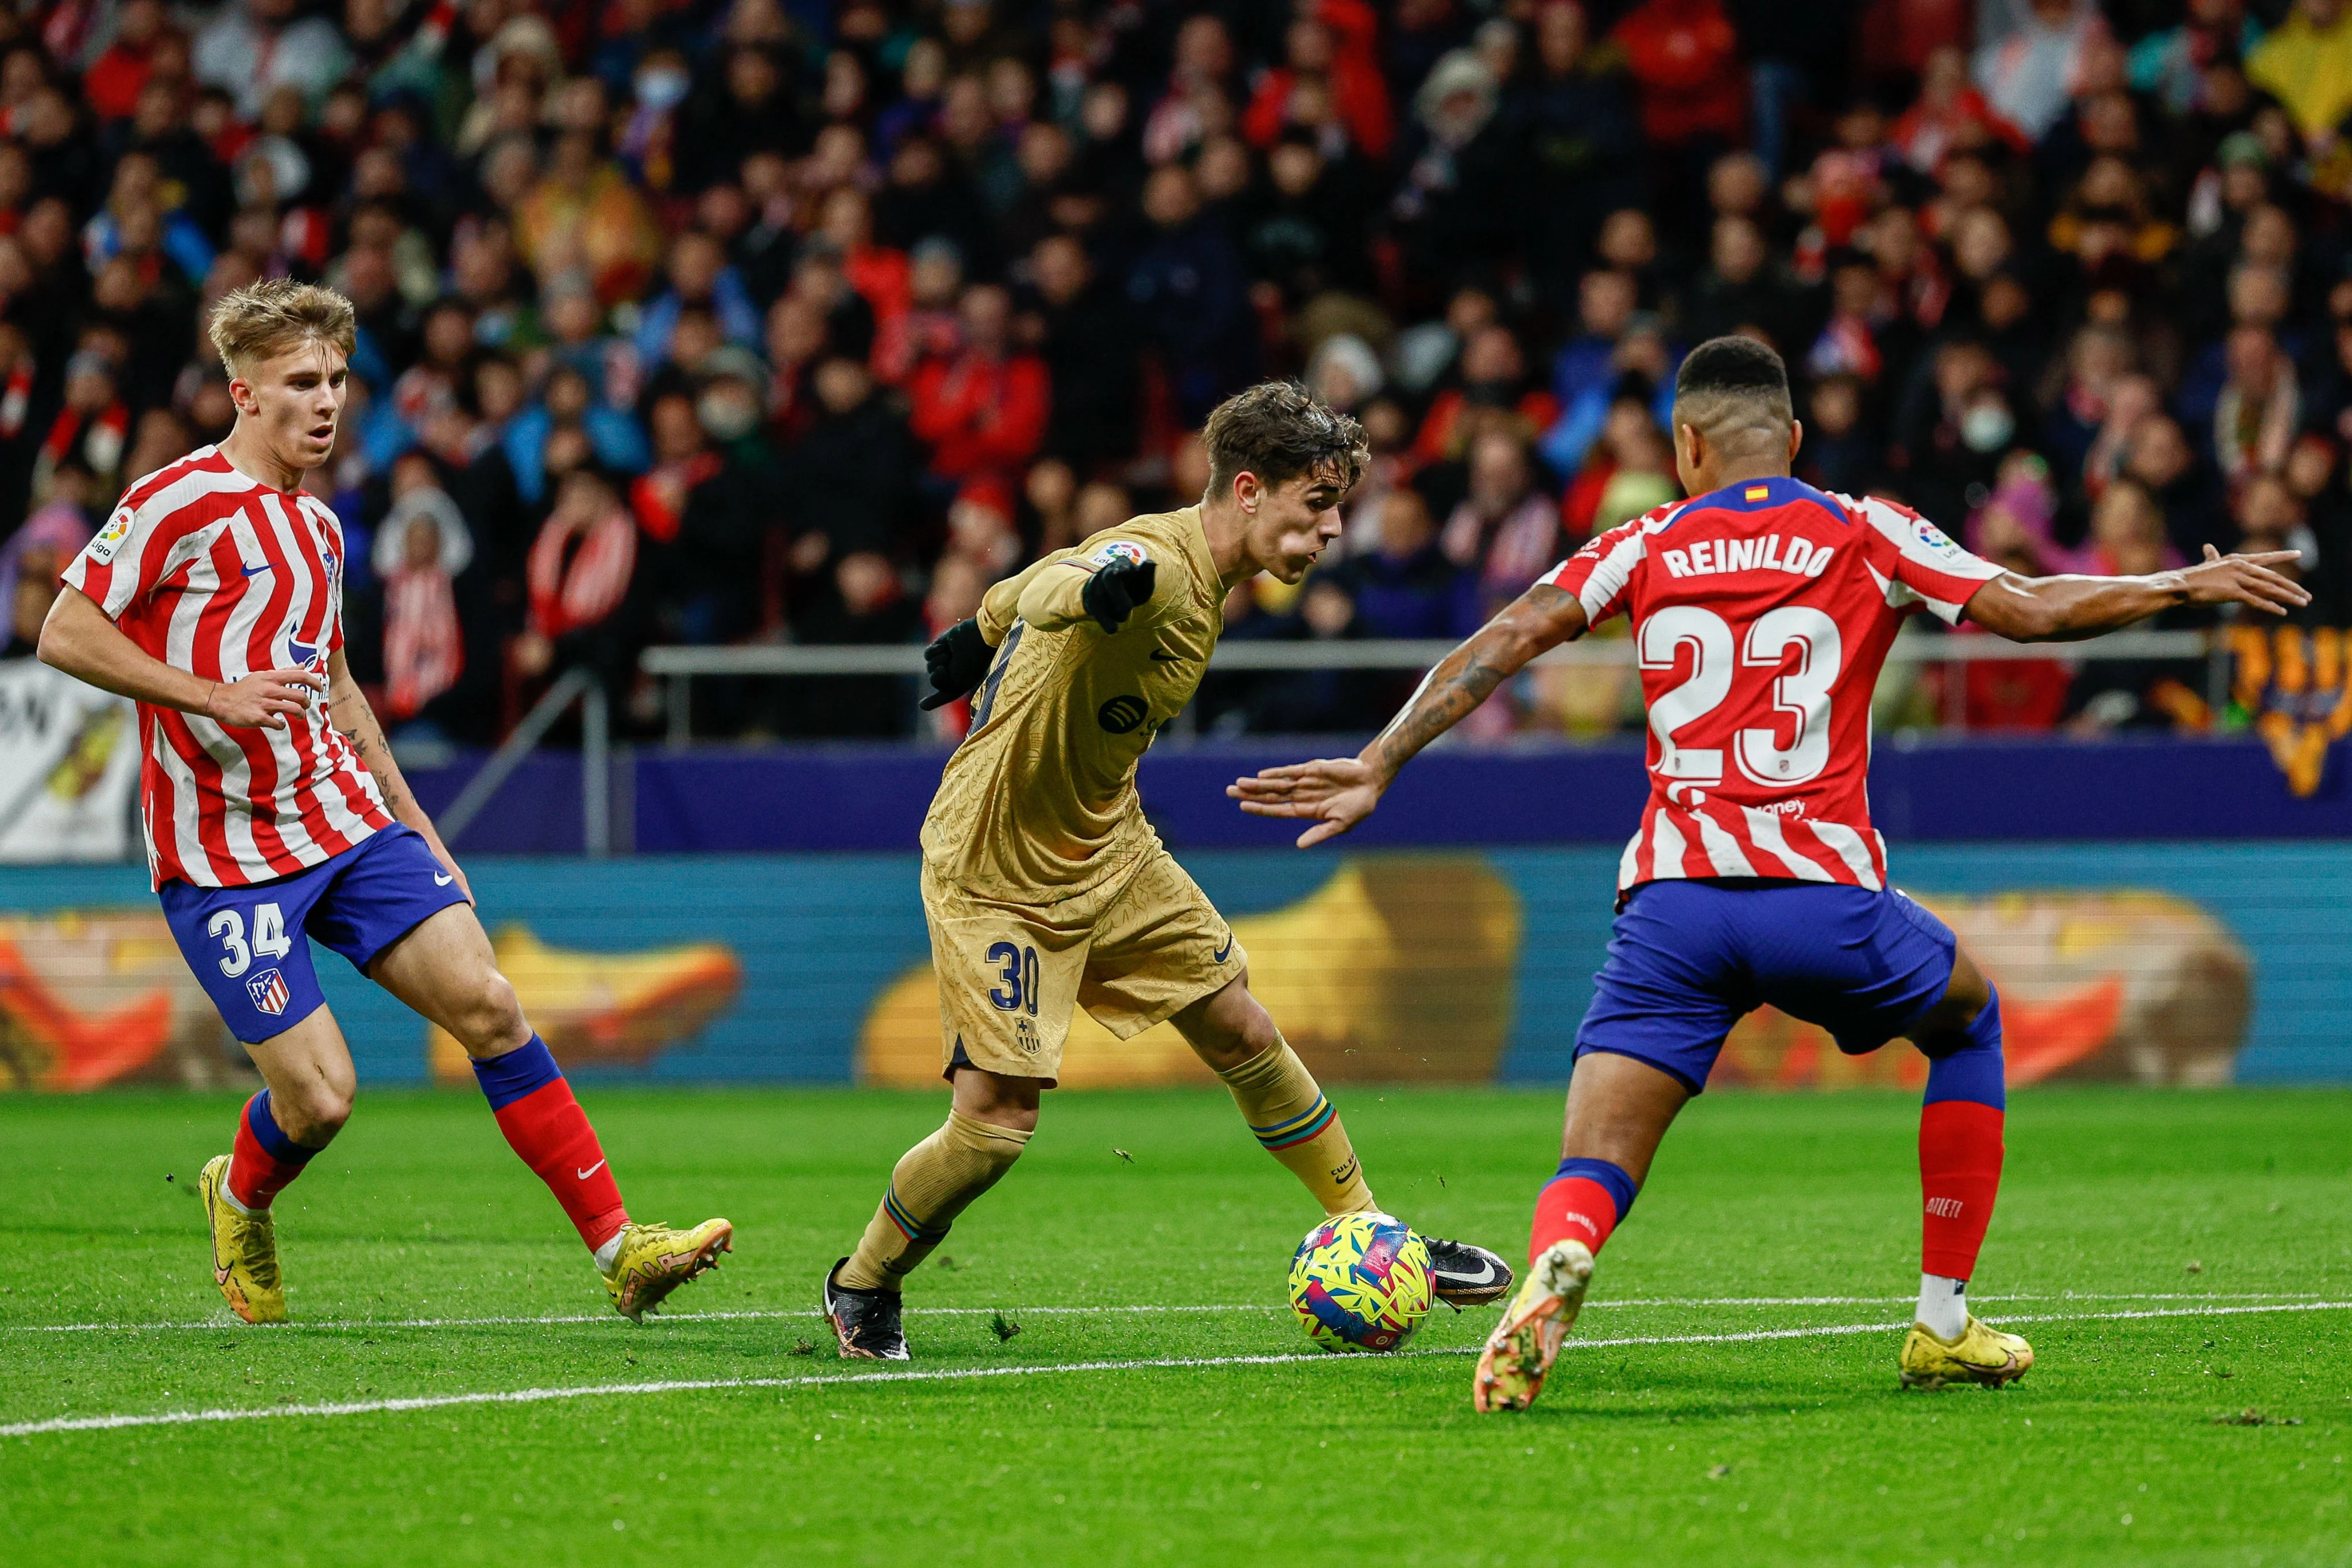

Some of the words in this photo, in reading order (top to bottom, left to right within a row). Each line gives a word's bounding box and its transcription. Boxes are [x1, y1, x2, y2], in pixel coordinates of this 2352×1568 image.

[92, 540, 111, 557] Liga
[1661, 533, 1835, 578] REINILDO
[1638, 605, 1842, 788] 23
[208, 902, 292, 978] 34
[985, 941, 1039, 1017] 30
[1330, 1150, 1355, 1175] CULER
